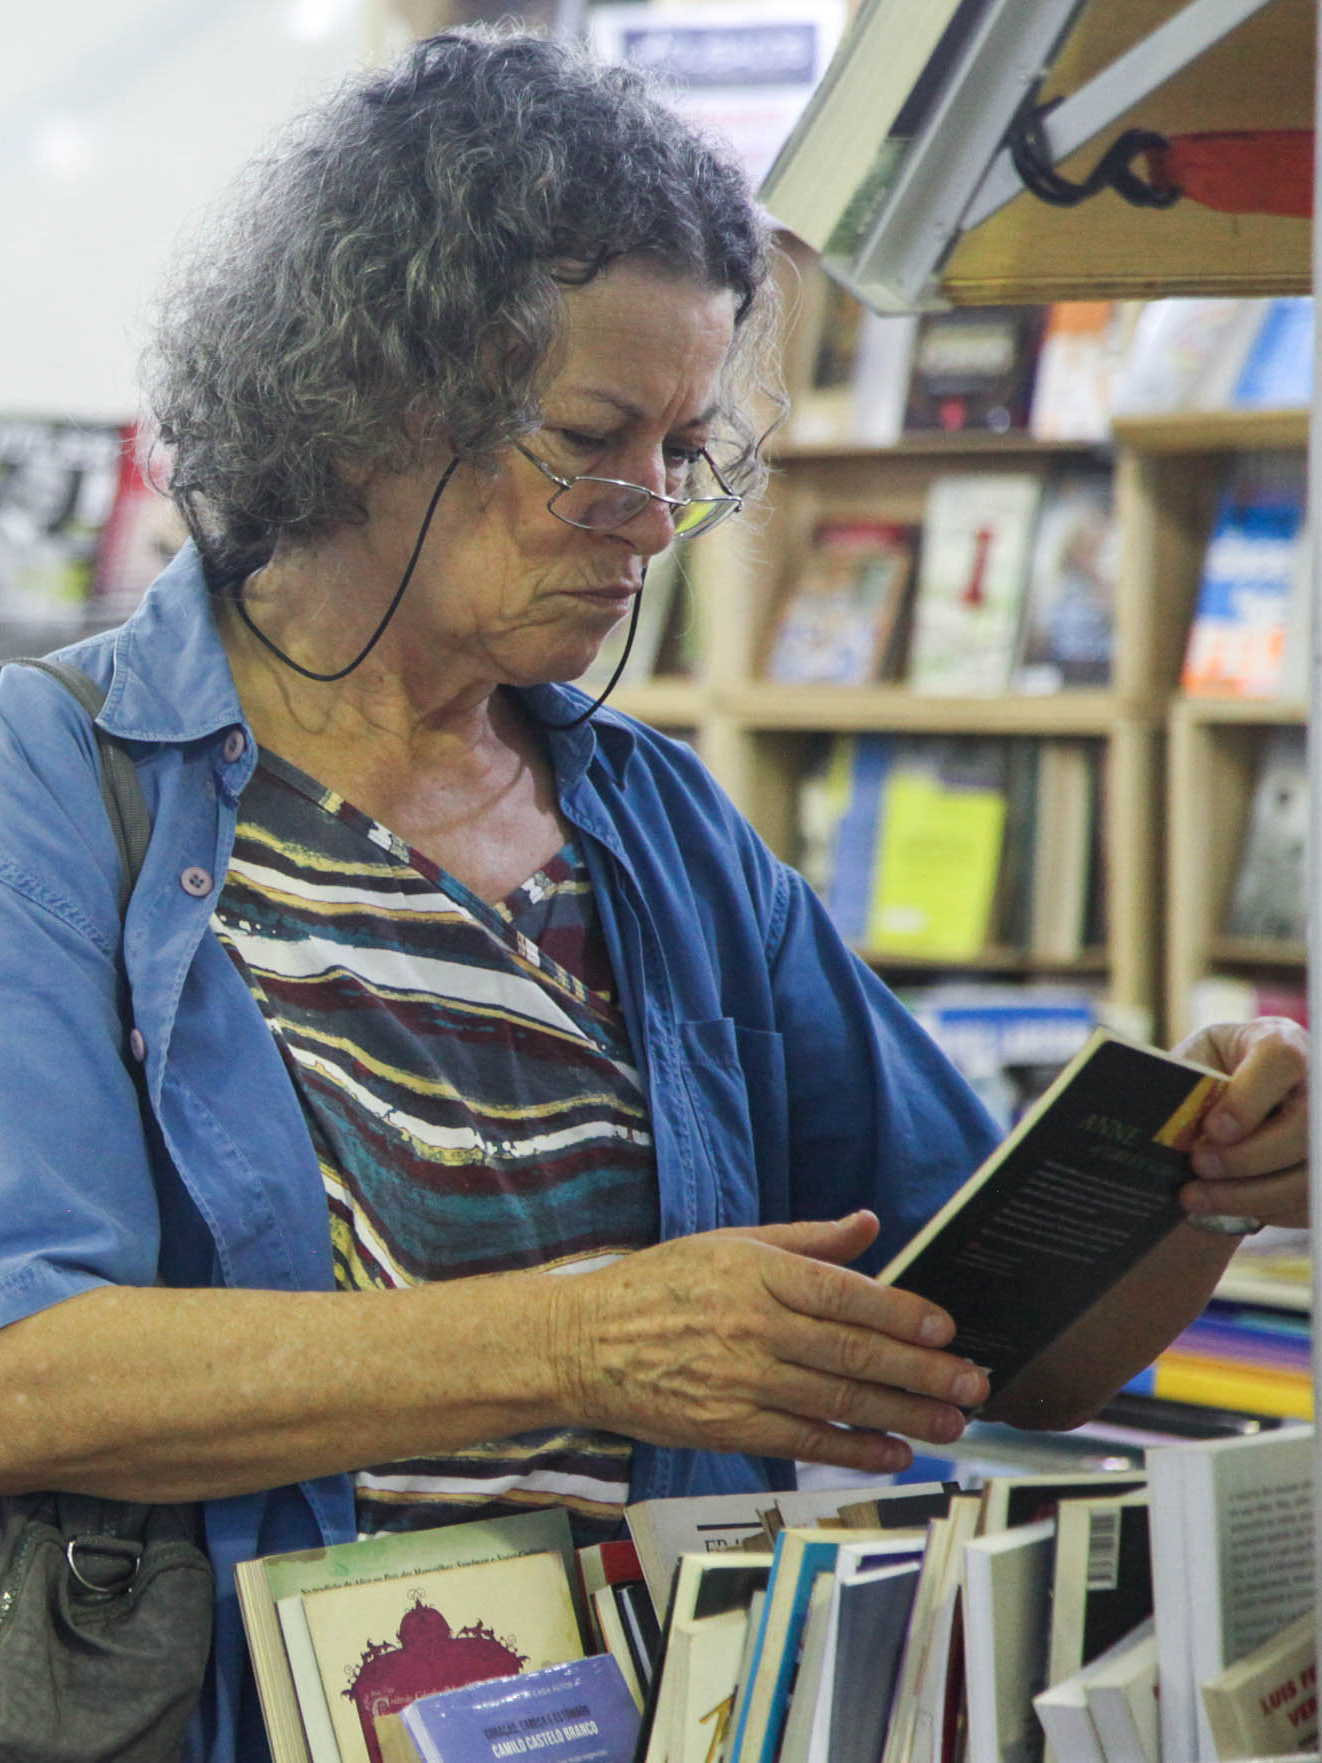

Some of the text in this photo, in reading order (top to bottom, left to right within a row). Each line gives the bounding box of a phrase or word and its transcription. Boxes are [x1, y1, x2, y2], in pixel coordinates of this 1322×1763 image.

[1259, 1680, 1297, 1716] LUIS
[491, 1719, 599, 1760] CAMILO CASTELO BRANCO
